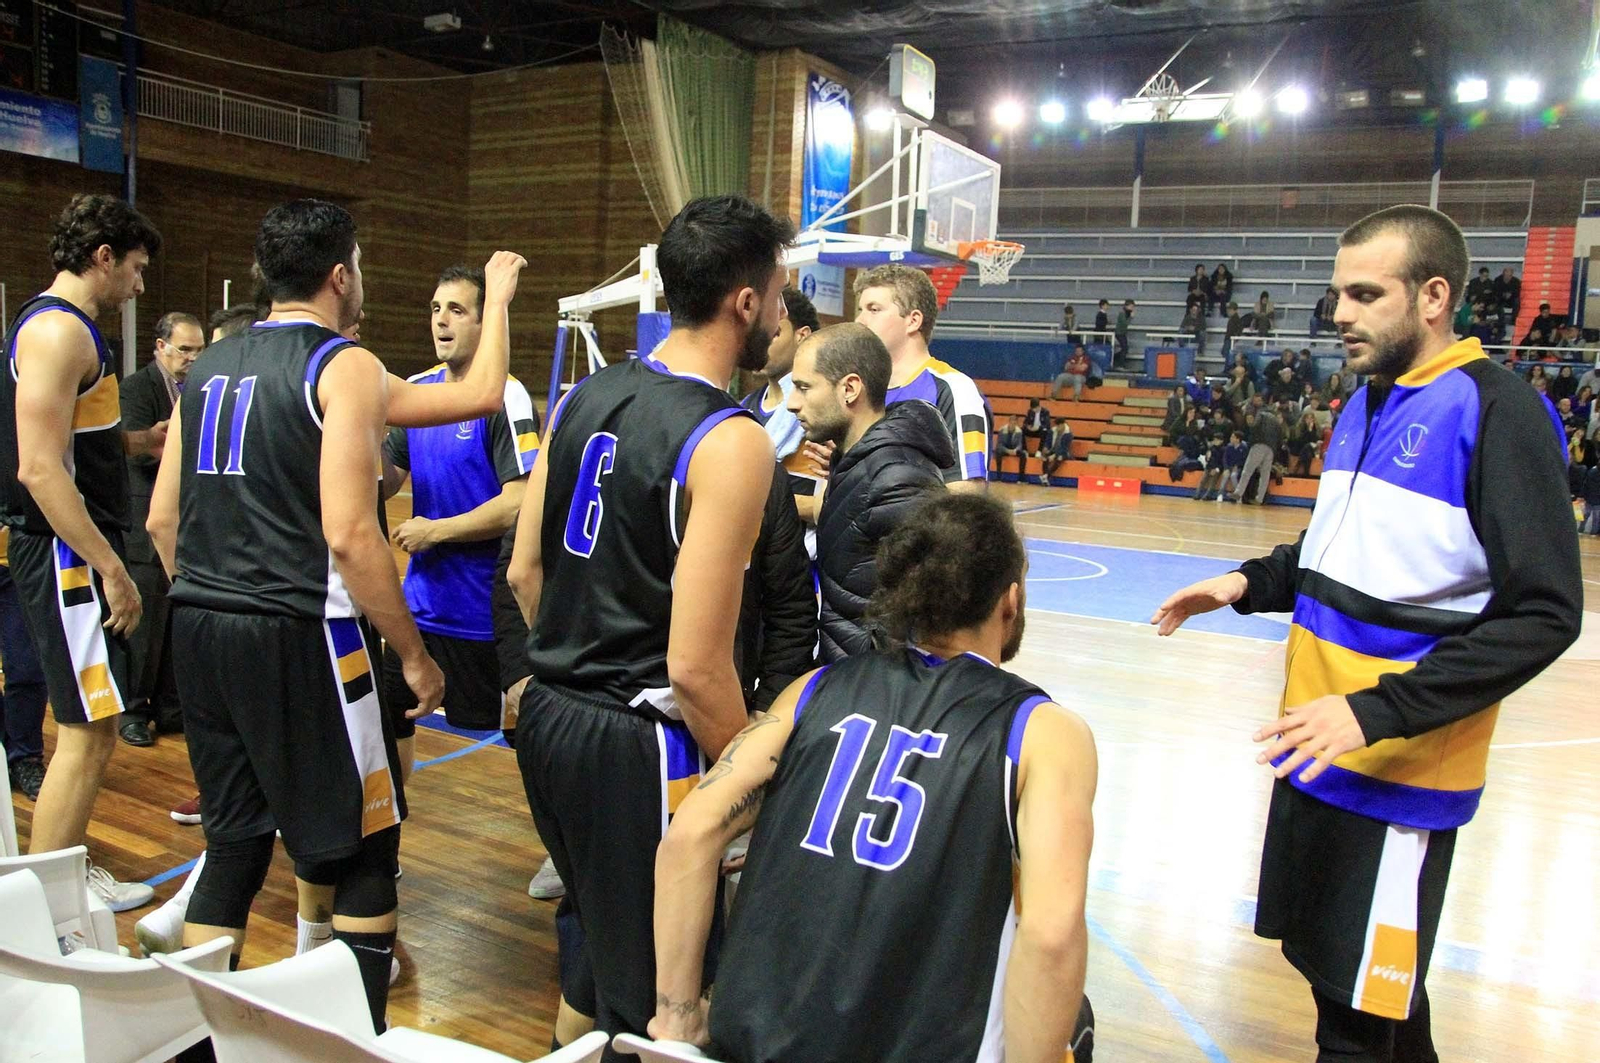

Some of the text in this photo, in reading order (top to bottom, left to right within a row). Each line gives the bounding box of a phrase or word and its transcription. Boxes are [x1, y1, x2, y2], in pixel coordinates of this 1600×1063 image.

[197, 374, 258, 476] 11
[563, 431, 619, 560] 6
[800, 713, 949, 872] 15
